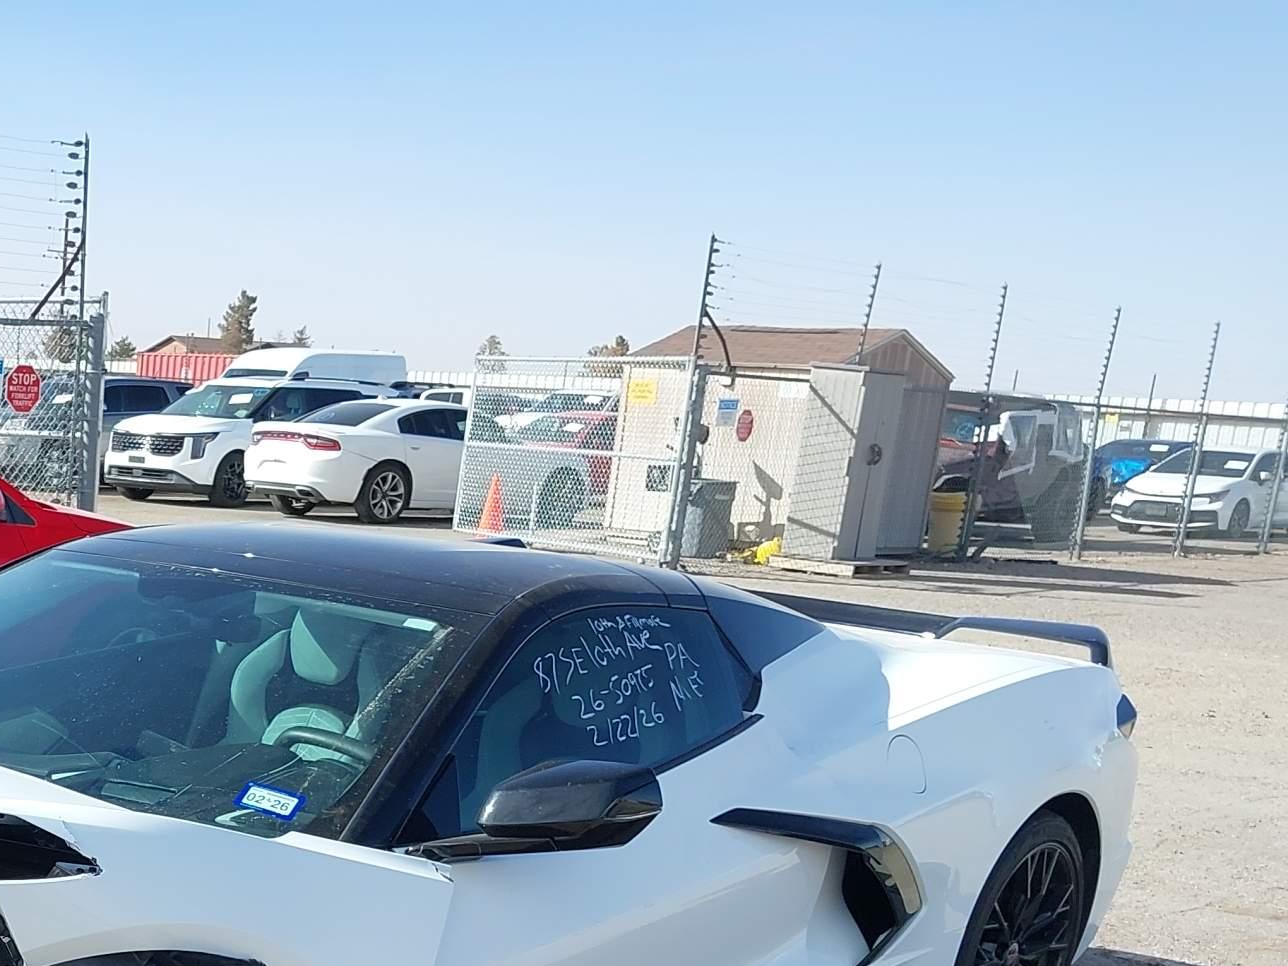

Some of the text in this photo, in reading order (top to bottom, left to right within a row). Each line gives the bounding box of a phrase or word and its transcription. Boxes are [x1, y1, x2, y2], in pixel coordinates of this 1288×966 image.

[12, 373, 37, 385] STOP
[533, 652, 561, 695] 87
[559, 647, 588, 685] SE
[623, 630, 663, 661] Ave
[664, 642, 700, 670] PA
[586, 701, 665, 746] 2/22/26
